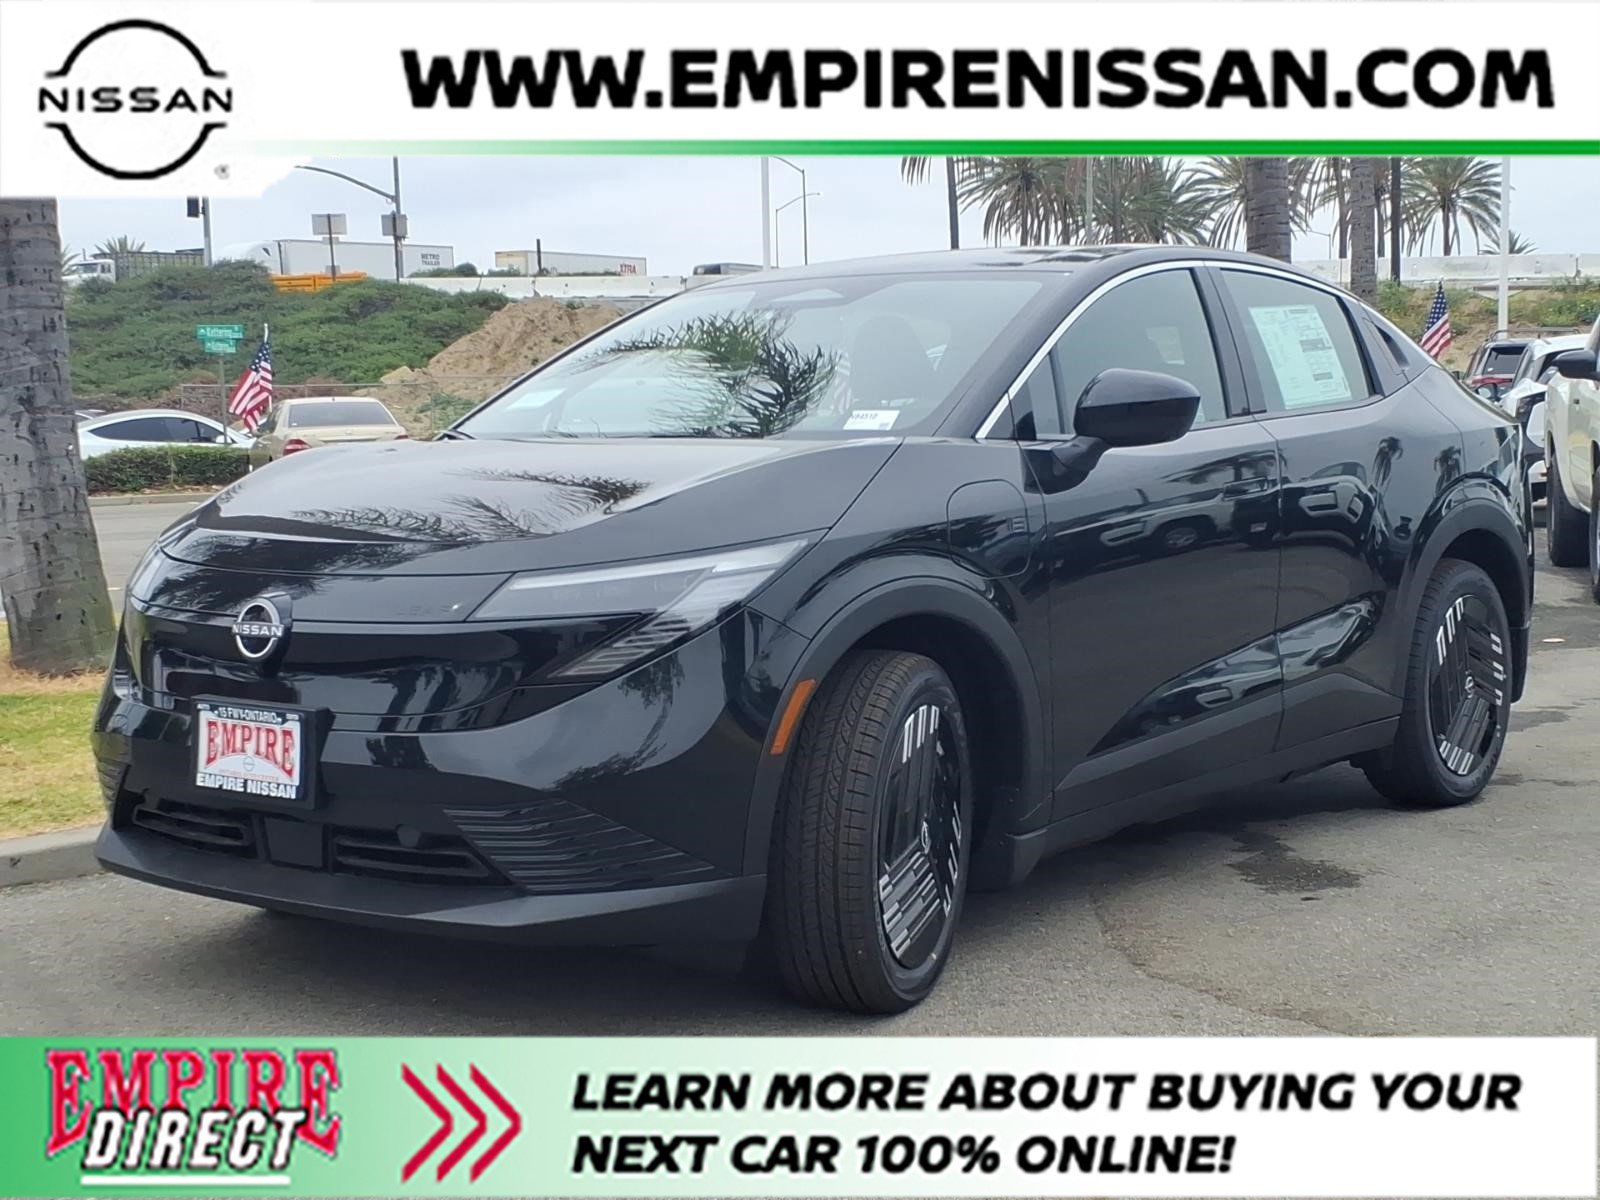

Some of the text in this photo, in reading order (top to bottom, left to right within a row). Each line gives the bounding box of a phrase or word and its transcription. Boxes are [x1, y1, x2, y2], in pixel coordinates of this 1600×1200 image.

[421, 253, 440, 262] METRO
[232, 624, 283, 637] NISSAN
[206, 720, 294, 777] EMPIRE
[197, 773, 244, 791] EMPIRE
[247, 780, 296, 799] NISSAN
